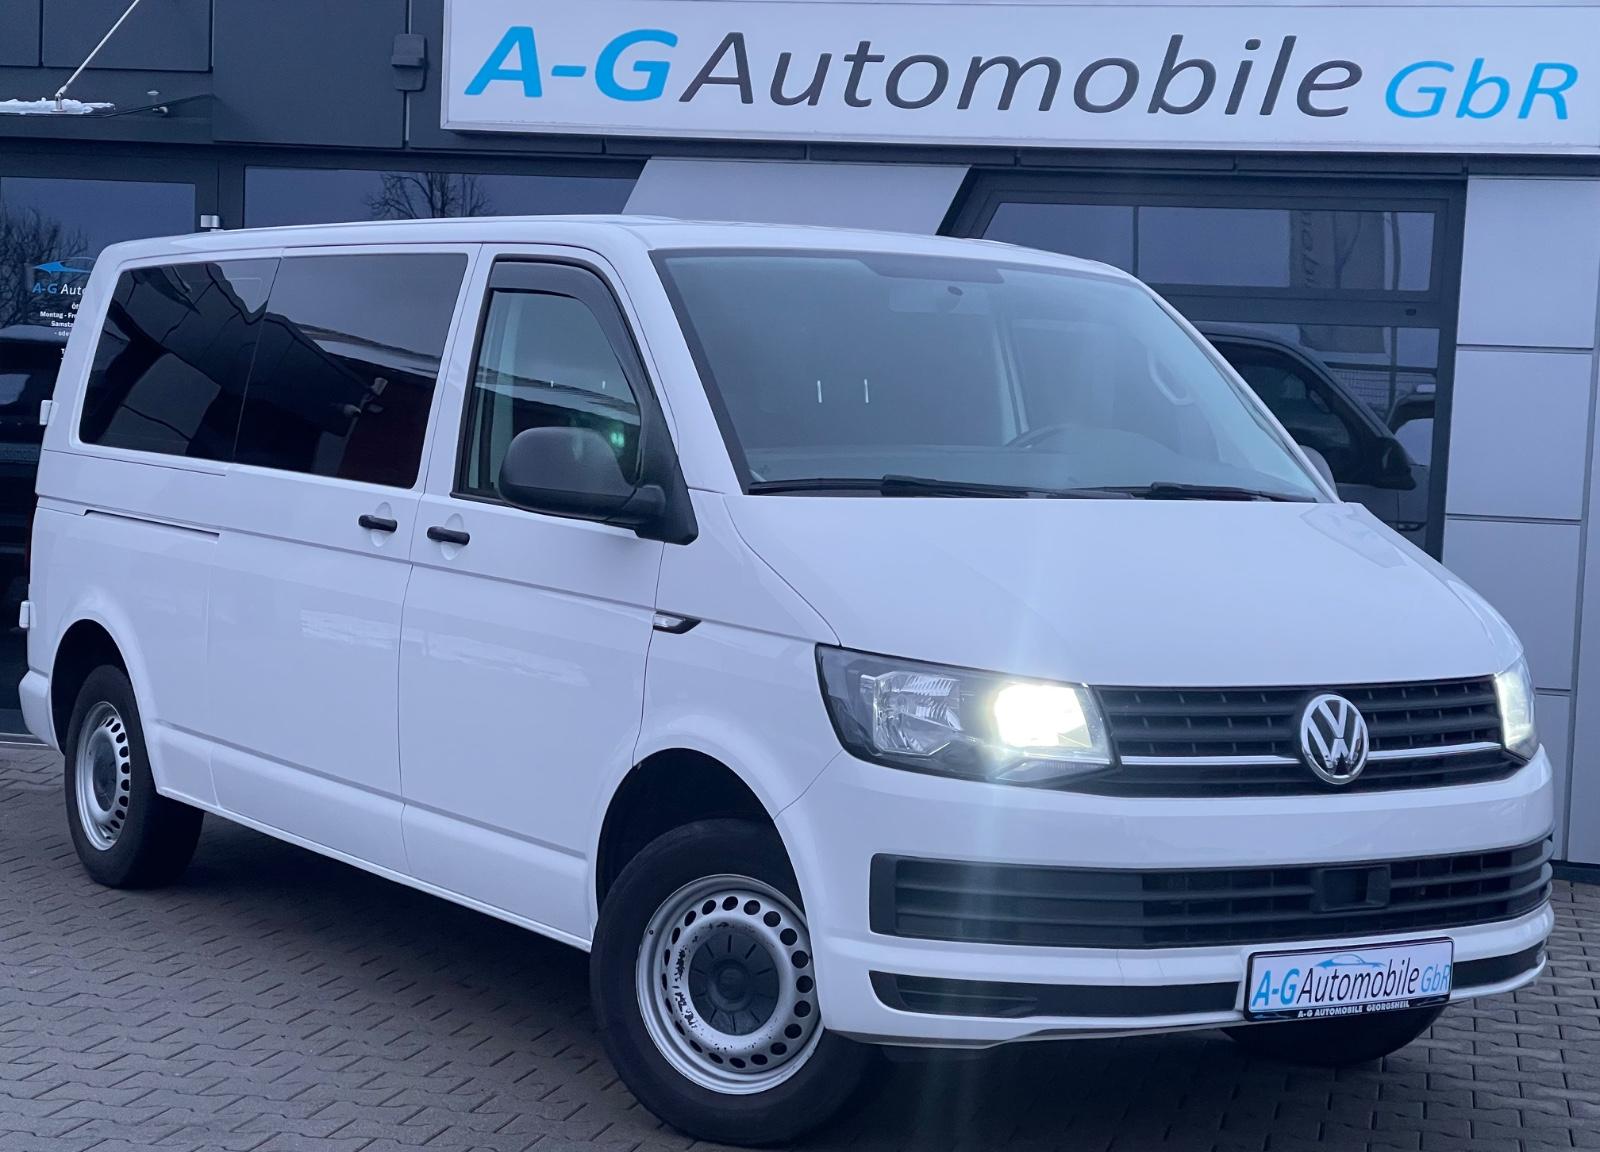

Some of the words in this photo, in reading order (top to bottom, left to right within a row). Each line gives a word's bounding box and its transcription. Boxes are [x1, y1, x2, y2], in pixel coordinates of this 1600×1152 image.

[464, 26, 679, 104] A-G
[679, 32, 1363, 119] Automobile
[1384, 56, 1579, 121] GbR
[32, 282, 58, 294] A-G
[40, 311, 63, 319] Montag
[1252, 968, 1300, 1007] A-G
[1296, 957, 1420, 1005] Automobile
[1421, 963, 1451, 993] GbR
[1297, 1007, 1313, 1018] A-G
[1314, 1004, 1363, 1017] AUTOMOBILE
